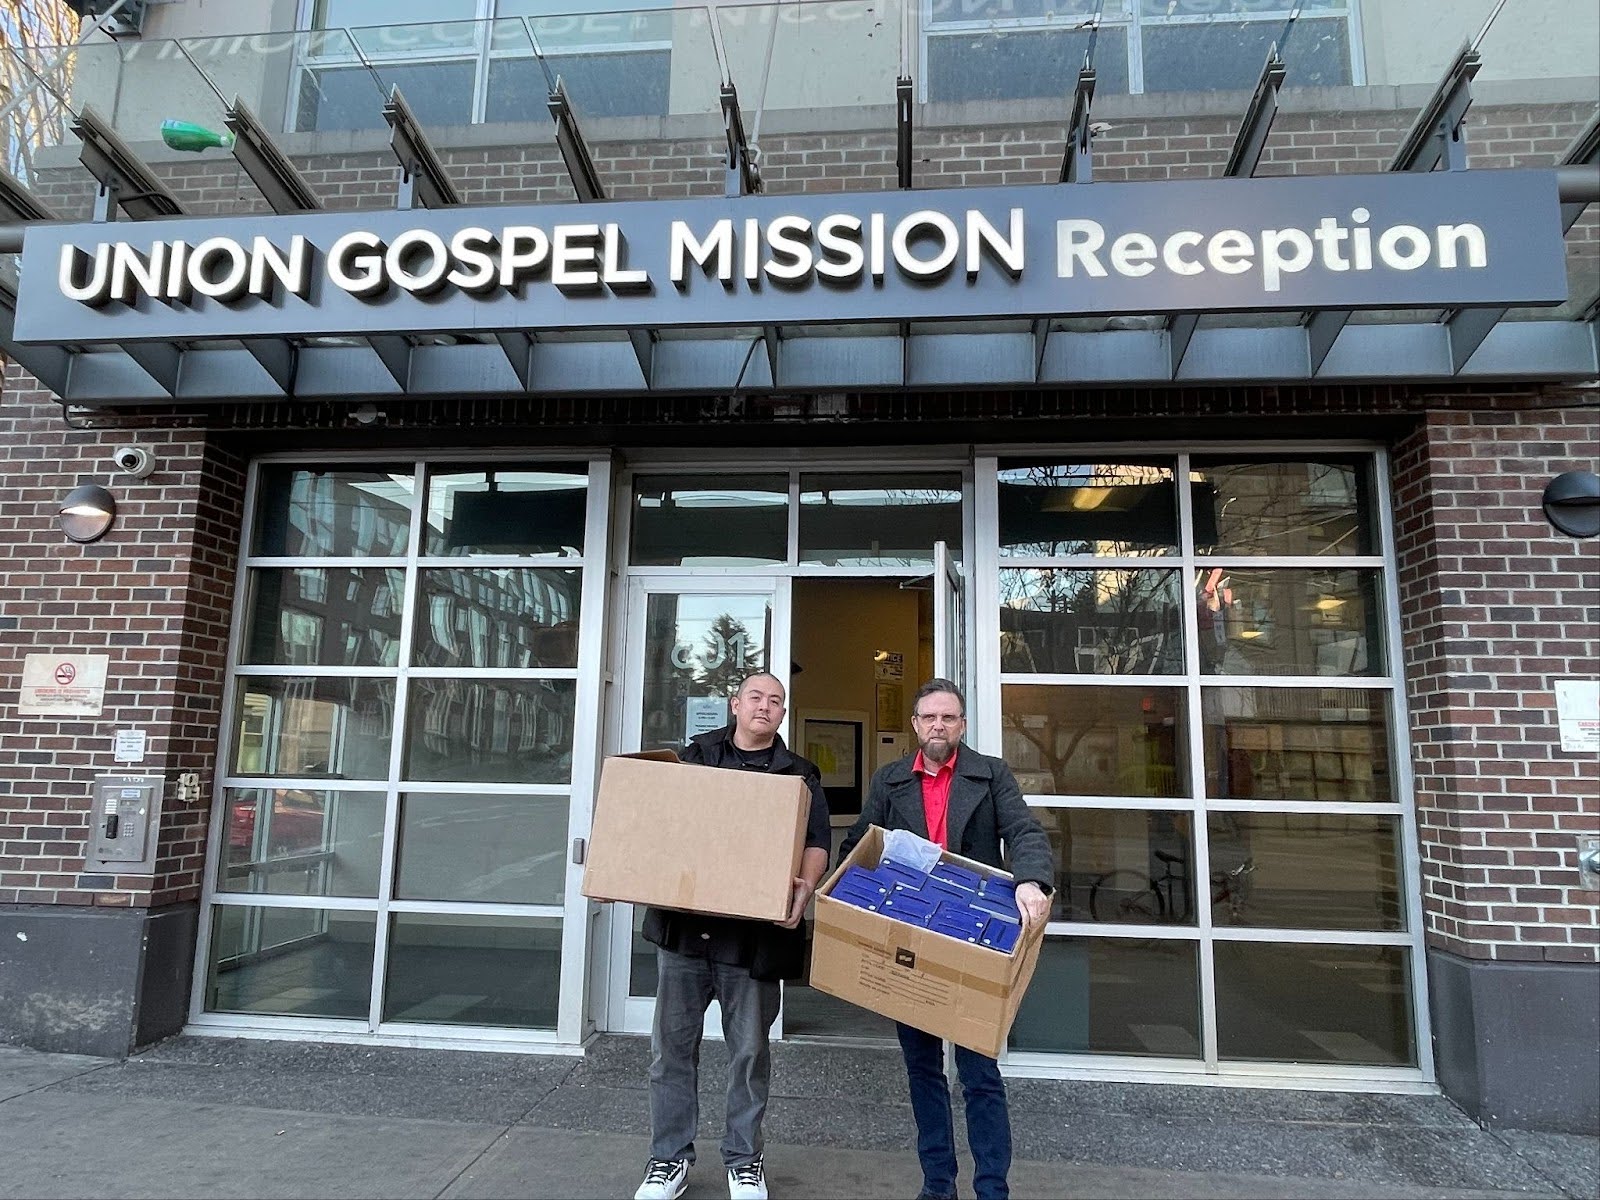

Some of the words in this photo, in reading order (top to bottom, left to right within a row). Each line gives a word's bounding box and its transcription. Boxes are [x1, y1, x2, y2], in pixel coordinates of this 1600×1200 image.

[58, 234, 304, 301] UNION
[326, 223, 648, 292] GOSPEL
[670, 207, 1025, 284] MISSION
[1056, 207, 1488, 292] Reception
